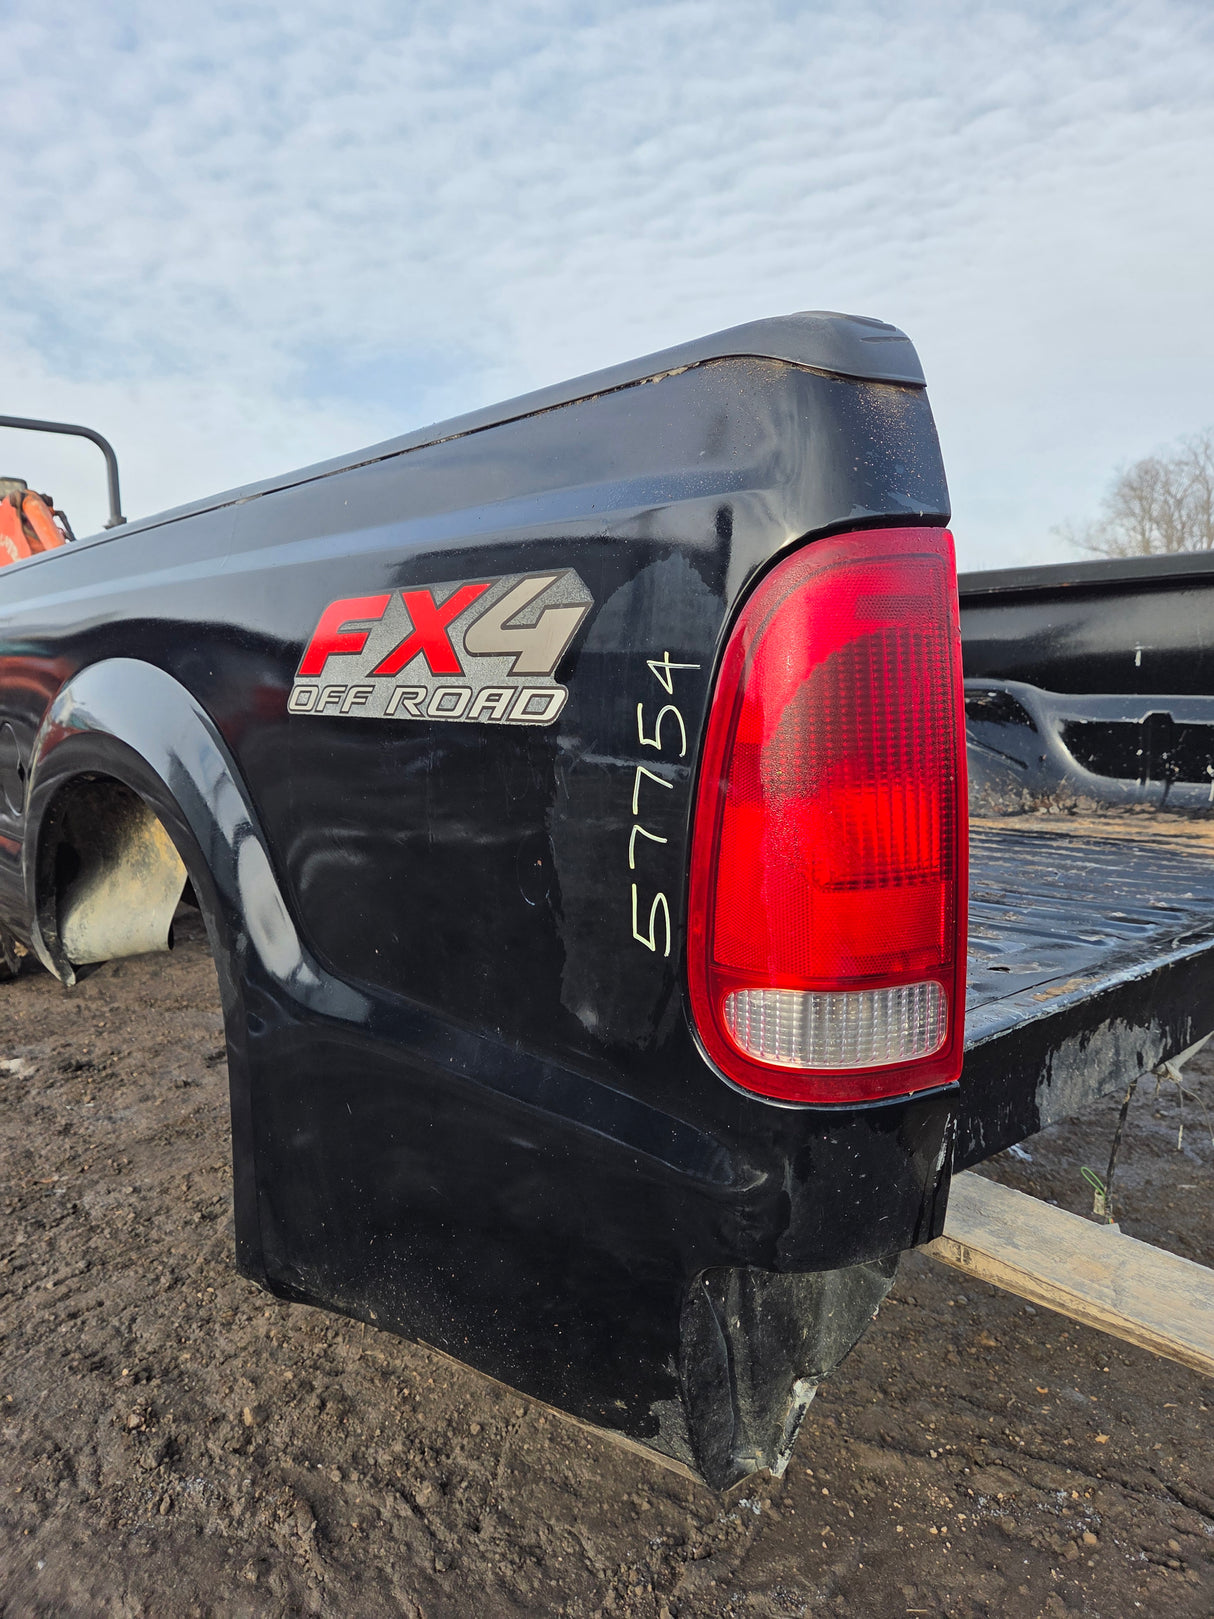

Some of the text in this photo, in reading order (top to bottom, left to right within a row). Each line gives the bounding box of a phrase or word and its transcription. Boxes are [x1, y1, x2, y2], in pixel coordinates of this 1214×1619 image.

[297, 574, 592, 678] FX4
[288, 684, 568, 723] OFF ROAD
[628, 650, 701, 957] 57754
